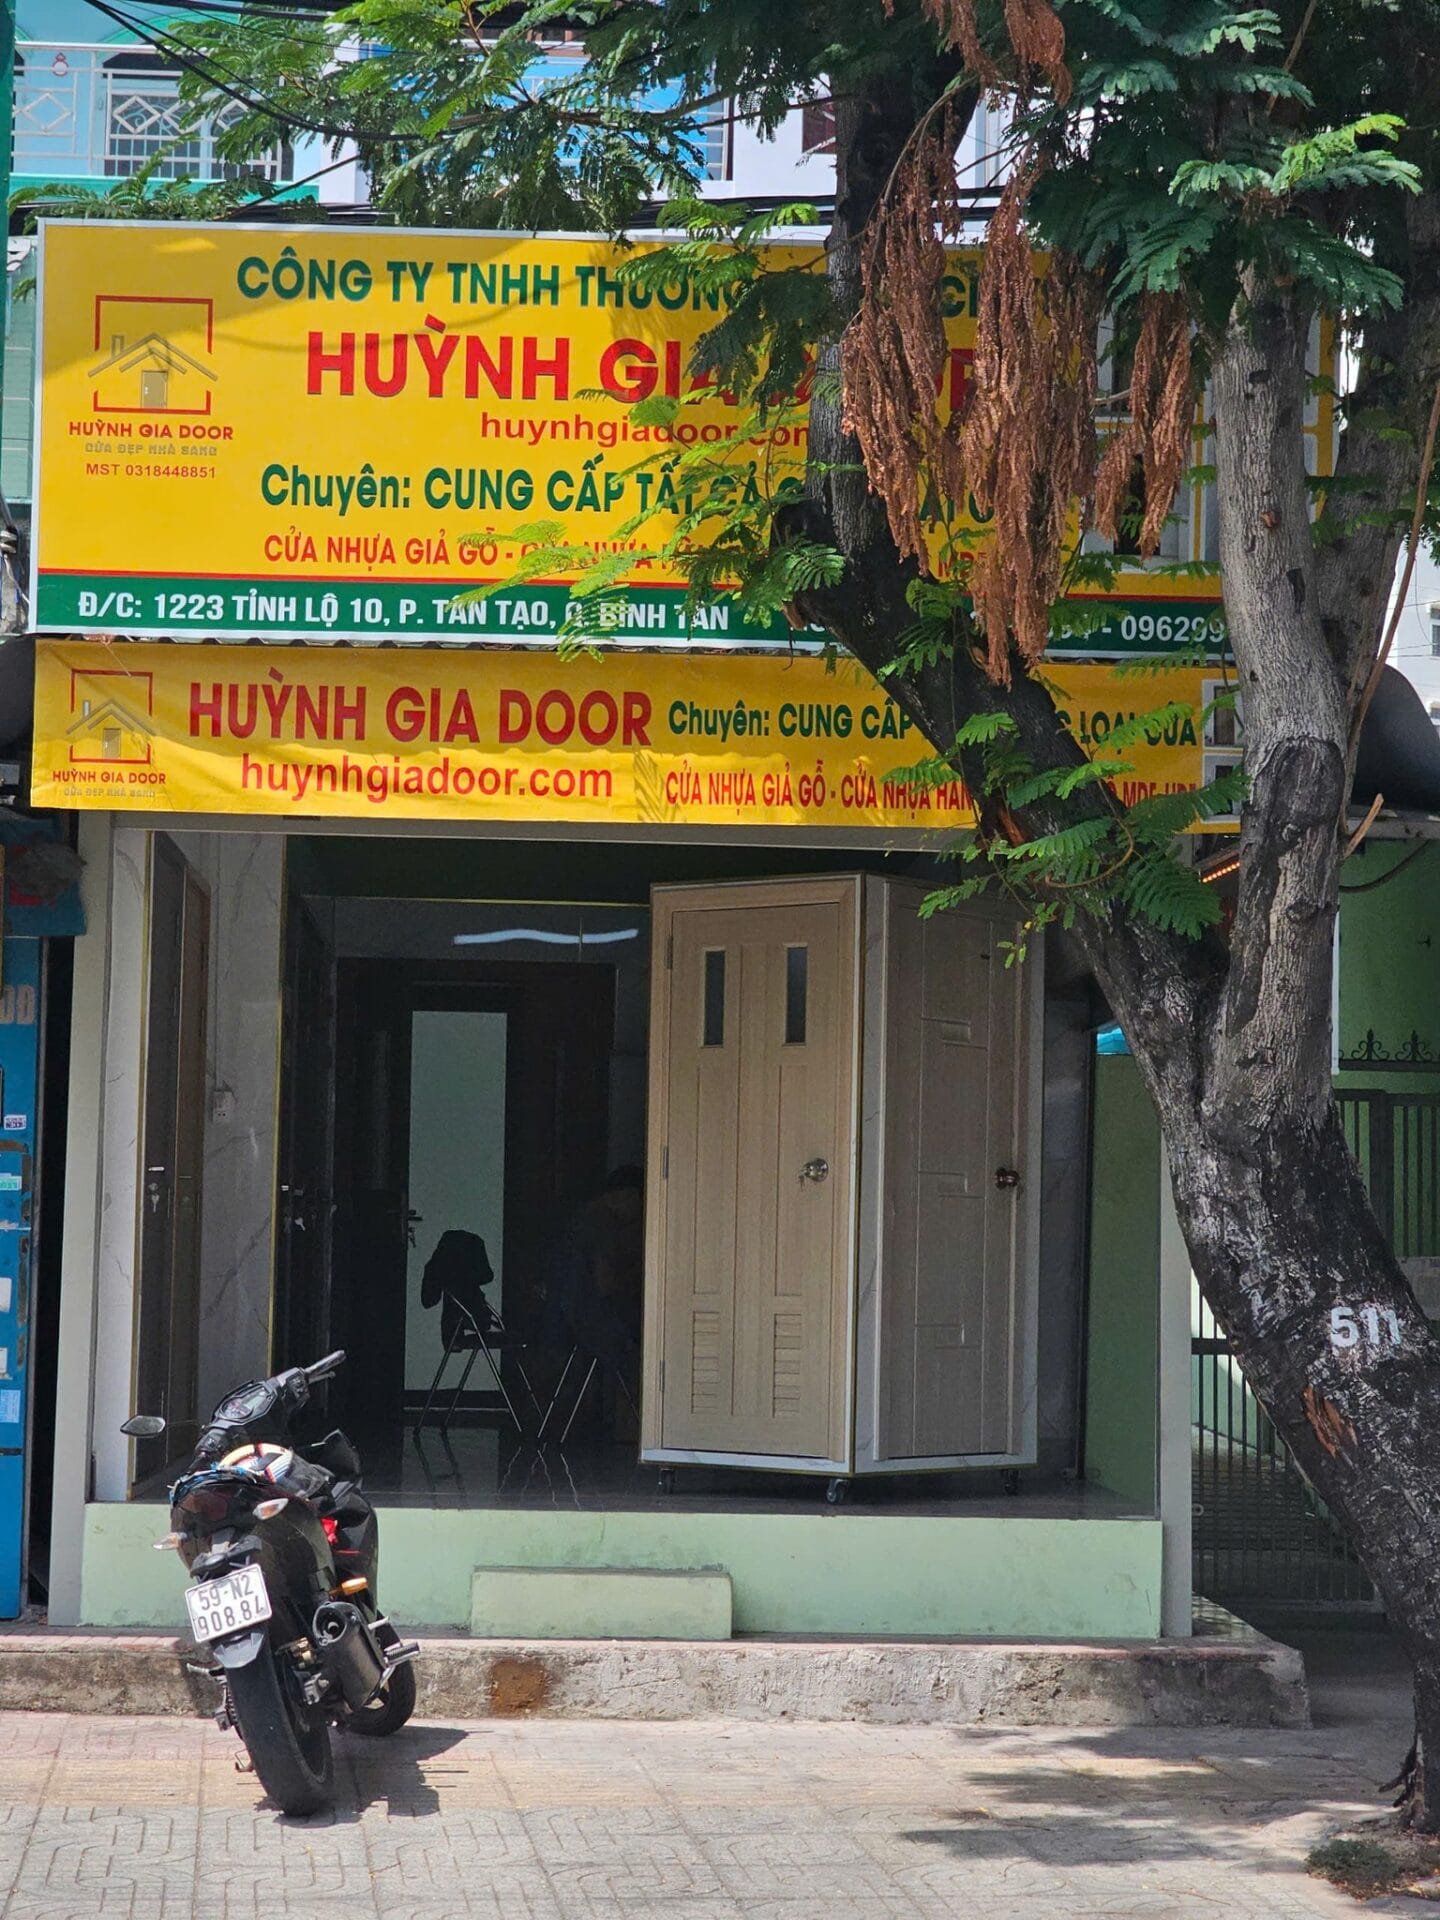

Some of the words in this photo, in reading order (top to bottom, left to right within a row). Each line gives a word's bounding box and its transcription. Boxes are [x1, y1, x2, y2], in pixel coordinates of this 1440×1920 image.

[237, 246, 372, 301] CÔNG
[386, 261, 434, 303] TY
[447, 262, 560, 306] TNHH
[306, 313, 570, 400] HUỲNH
[69, 419, 132, 437] HUỲNH
[139, 423, 172, 438] GIA
[179, 425, 233, 440] DOOR
[86, 463, 120, 476] MST
[125, 464, 216, 479] 0318448851
[261, 463, 411, 516] Chuyên:
[424, 467, 534, 511] CUNG
[546, 451, 625, 513] CẤP
[264, 525, 318, 563] CỬA
[327, 533, 397, 571] NHỰA
[405, 528, 450, 565] GIẢ
[78, 591, 142, 619] Đ/C:
[154, 594, 224, 621] 1223
[232, 588, 297, 622] TỈNH
[305, 592, 339, 627] LỘ
[350, 598, 390, 626] 10,
[399, 599, 424, 624] P.
[432, 595, 487, 625] TÂN
[495, 600, 556, 630] TẠO,
[189, 666, 367, 742] HUỲNH
[385, 686, 481, 743] GIA
[499, 689, 653, 747] DOOR
[668, 700, 770, 742] Chuyên:
[778, 702, 852, 739] CUNG
[52, 768, 96, 782] HUỲNH
[101, 771, 125, 783] GIA
[128, 773, 167, 784] DOOR
[241, 753, 613, 803] huynhgiadoor.com
[665, 759, 701, 805] CỬA
[708, 768, 756, 816] NHỰA
[762, 761, 794, 807] GIẢ
[800, 759, 826, 808] GỖ
[841, 763, 878, 808] CỬA
